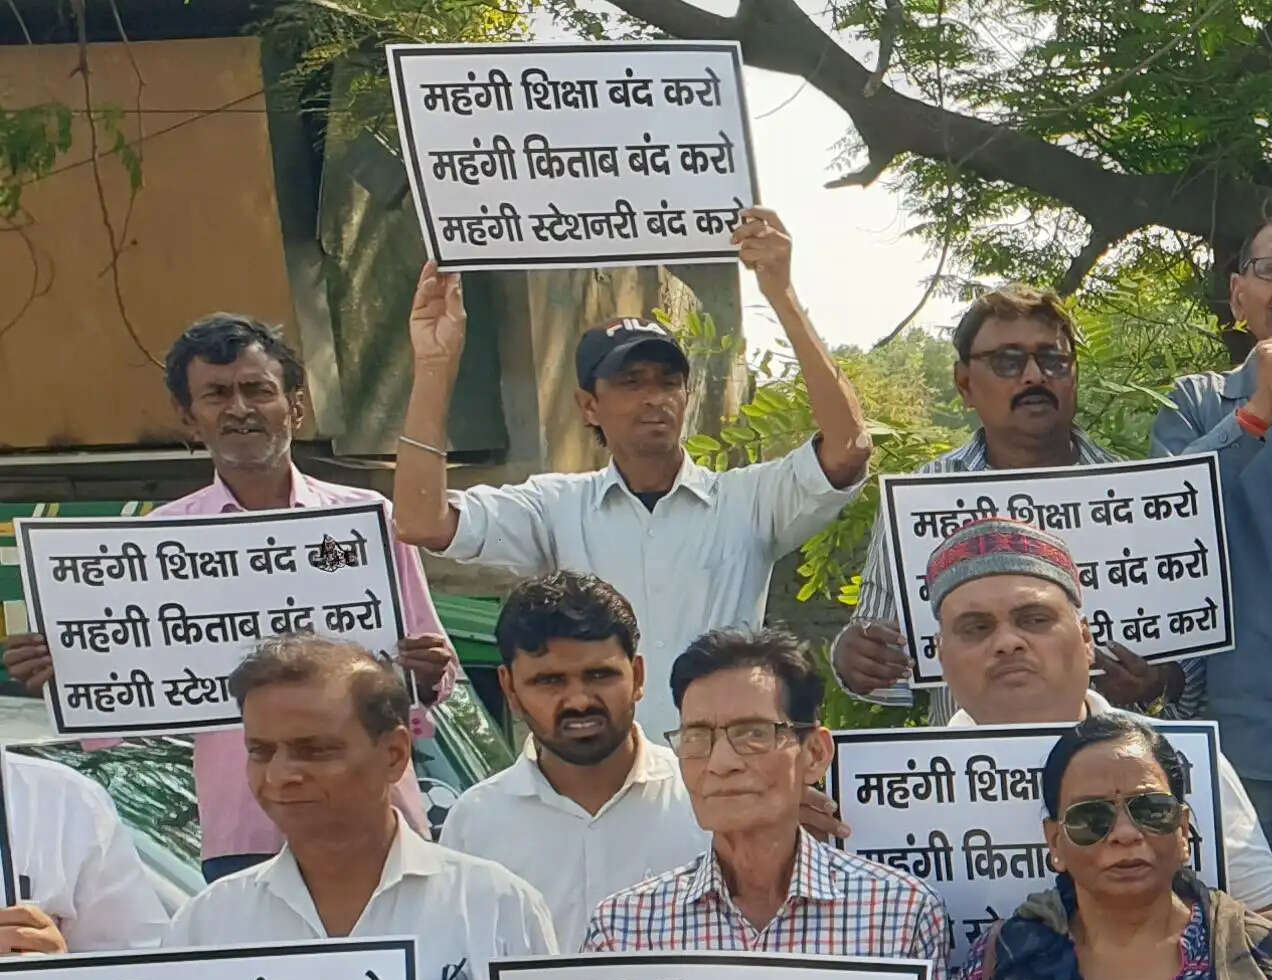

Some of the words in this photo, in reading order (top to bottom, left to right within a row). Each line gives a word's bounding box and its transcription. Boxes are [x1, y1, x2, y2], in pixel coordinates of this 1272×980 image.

[419, 68, 514, 116] महंगी
[520, 67, 599, 110] शिक्षा
[605, 67, 654, 108] बंद
[660, 67, 721, 107] करो
[438, 202, 524, 246] महंगी
[528, 199, 639, 242] स्टेशनरी
[643, 199, 688, 237] बंद
[1088, 488, 1134, 526] बंद
[1140, 480, 1199, 521] करो
[49, 542, 148, 587] महंगी
[155, 540, 239, 581] शिक्षा
[246, 536, 297, 575] बंद
[1104, 547, 1149, 588] बंद
[1154, 538, 1209, 582] करो
[56, 604, 152, 653] महंगी
[157, 602, 262, 646] किताब
[321, 588, 382, 633] करो
[63, 669, 155, 713] महंगी
[855, 756, 956, 808] महंगी
